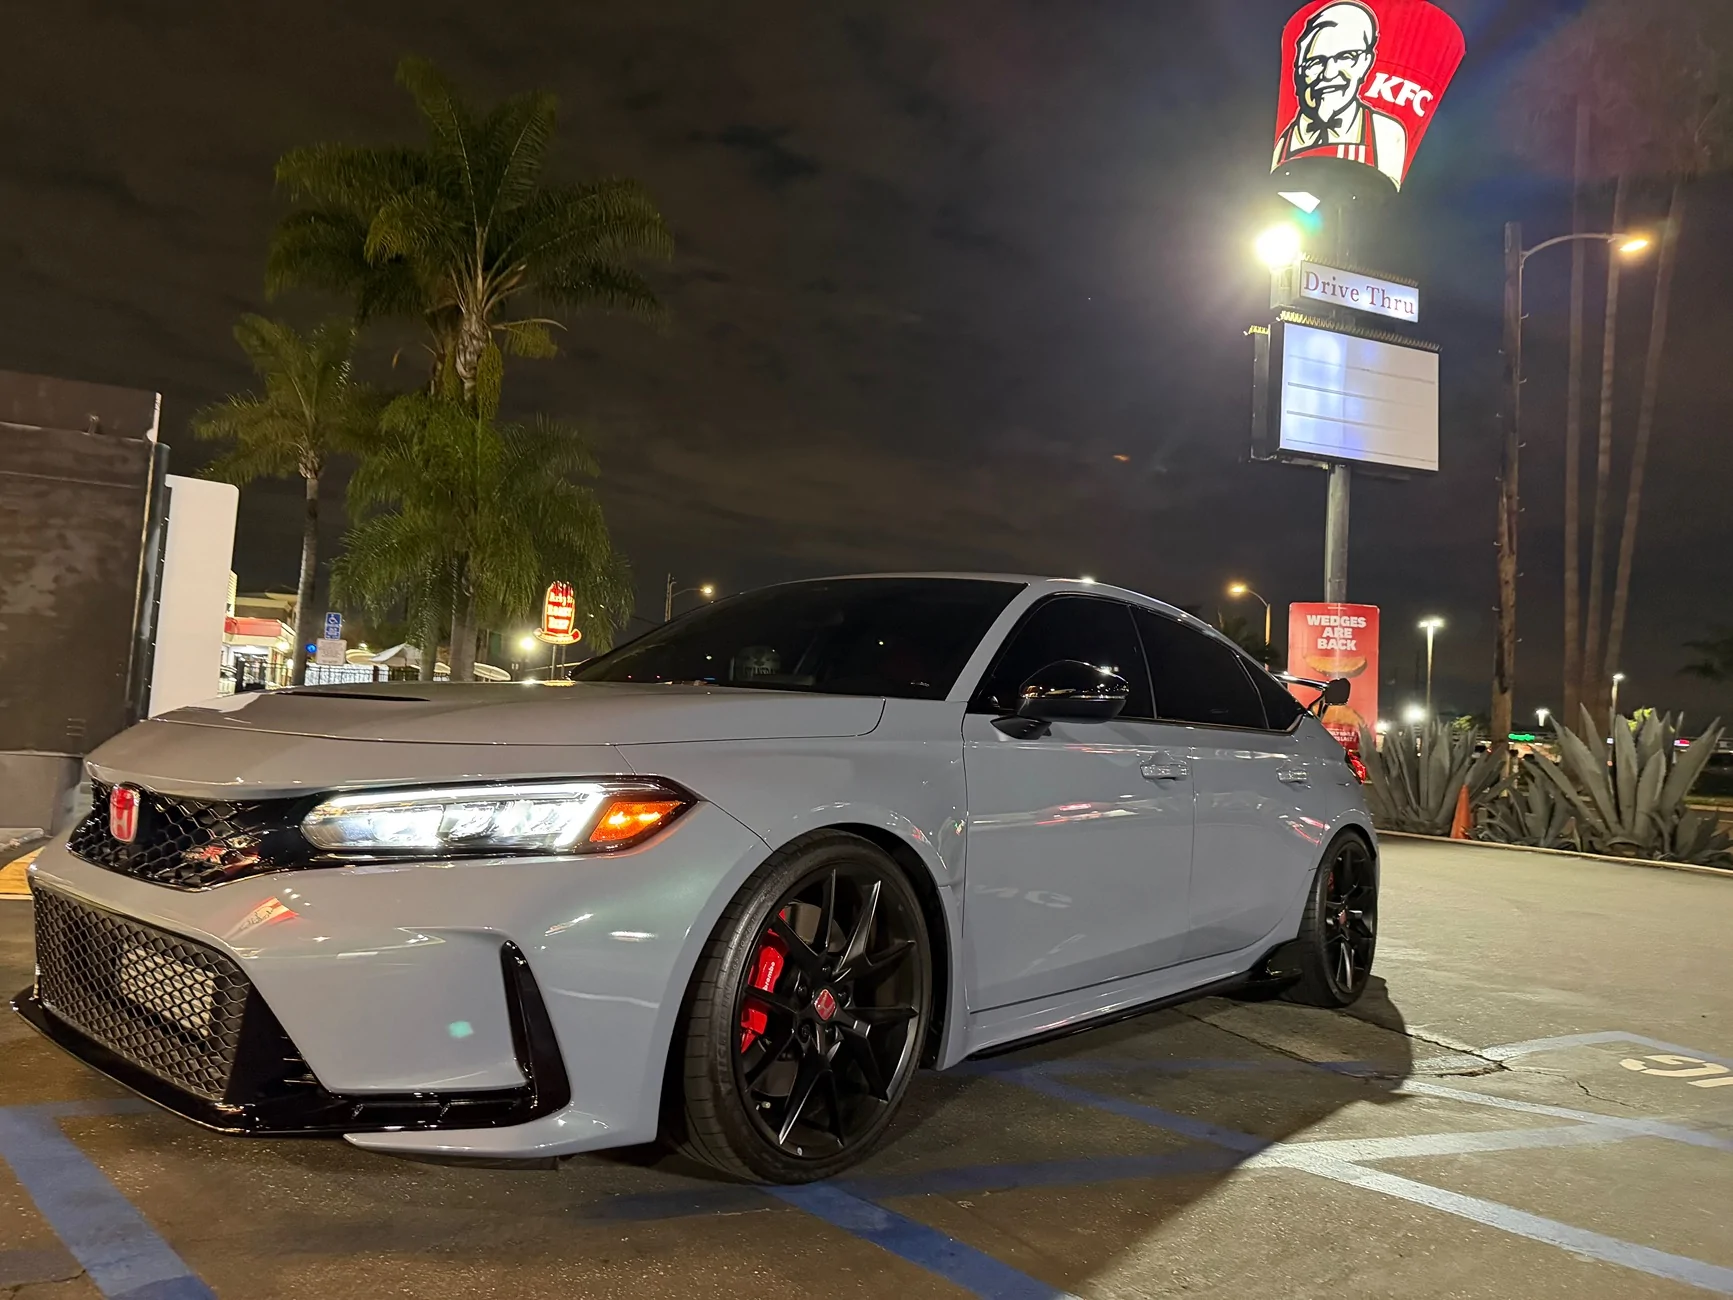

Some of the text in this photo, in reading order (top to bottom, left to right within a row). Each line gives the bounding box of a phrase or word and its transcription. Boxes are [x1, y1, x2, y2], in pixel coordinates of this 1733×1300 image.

[1364, 72, 1434, 117] KFC
[1304, 271, 1415, 315] Drive Thru
[1306, 614, 1367, 628] WEDGES
[1322, 627, 1353, 639] ARE
[1317, 638, 1357, 651] BACK
[762, 961, 776, 991] brembo
